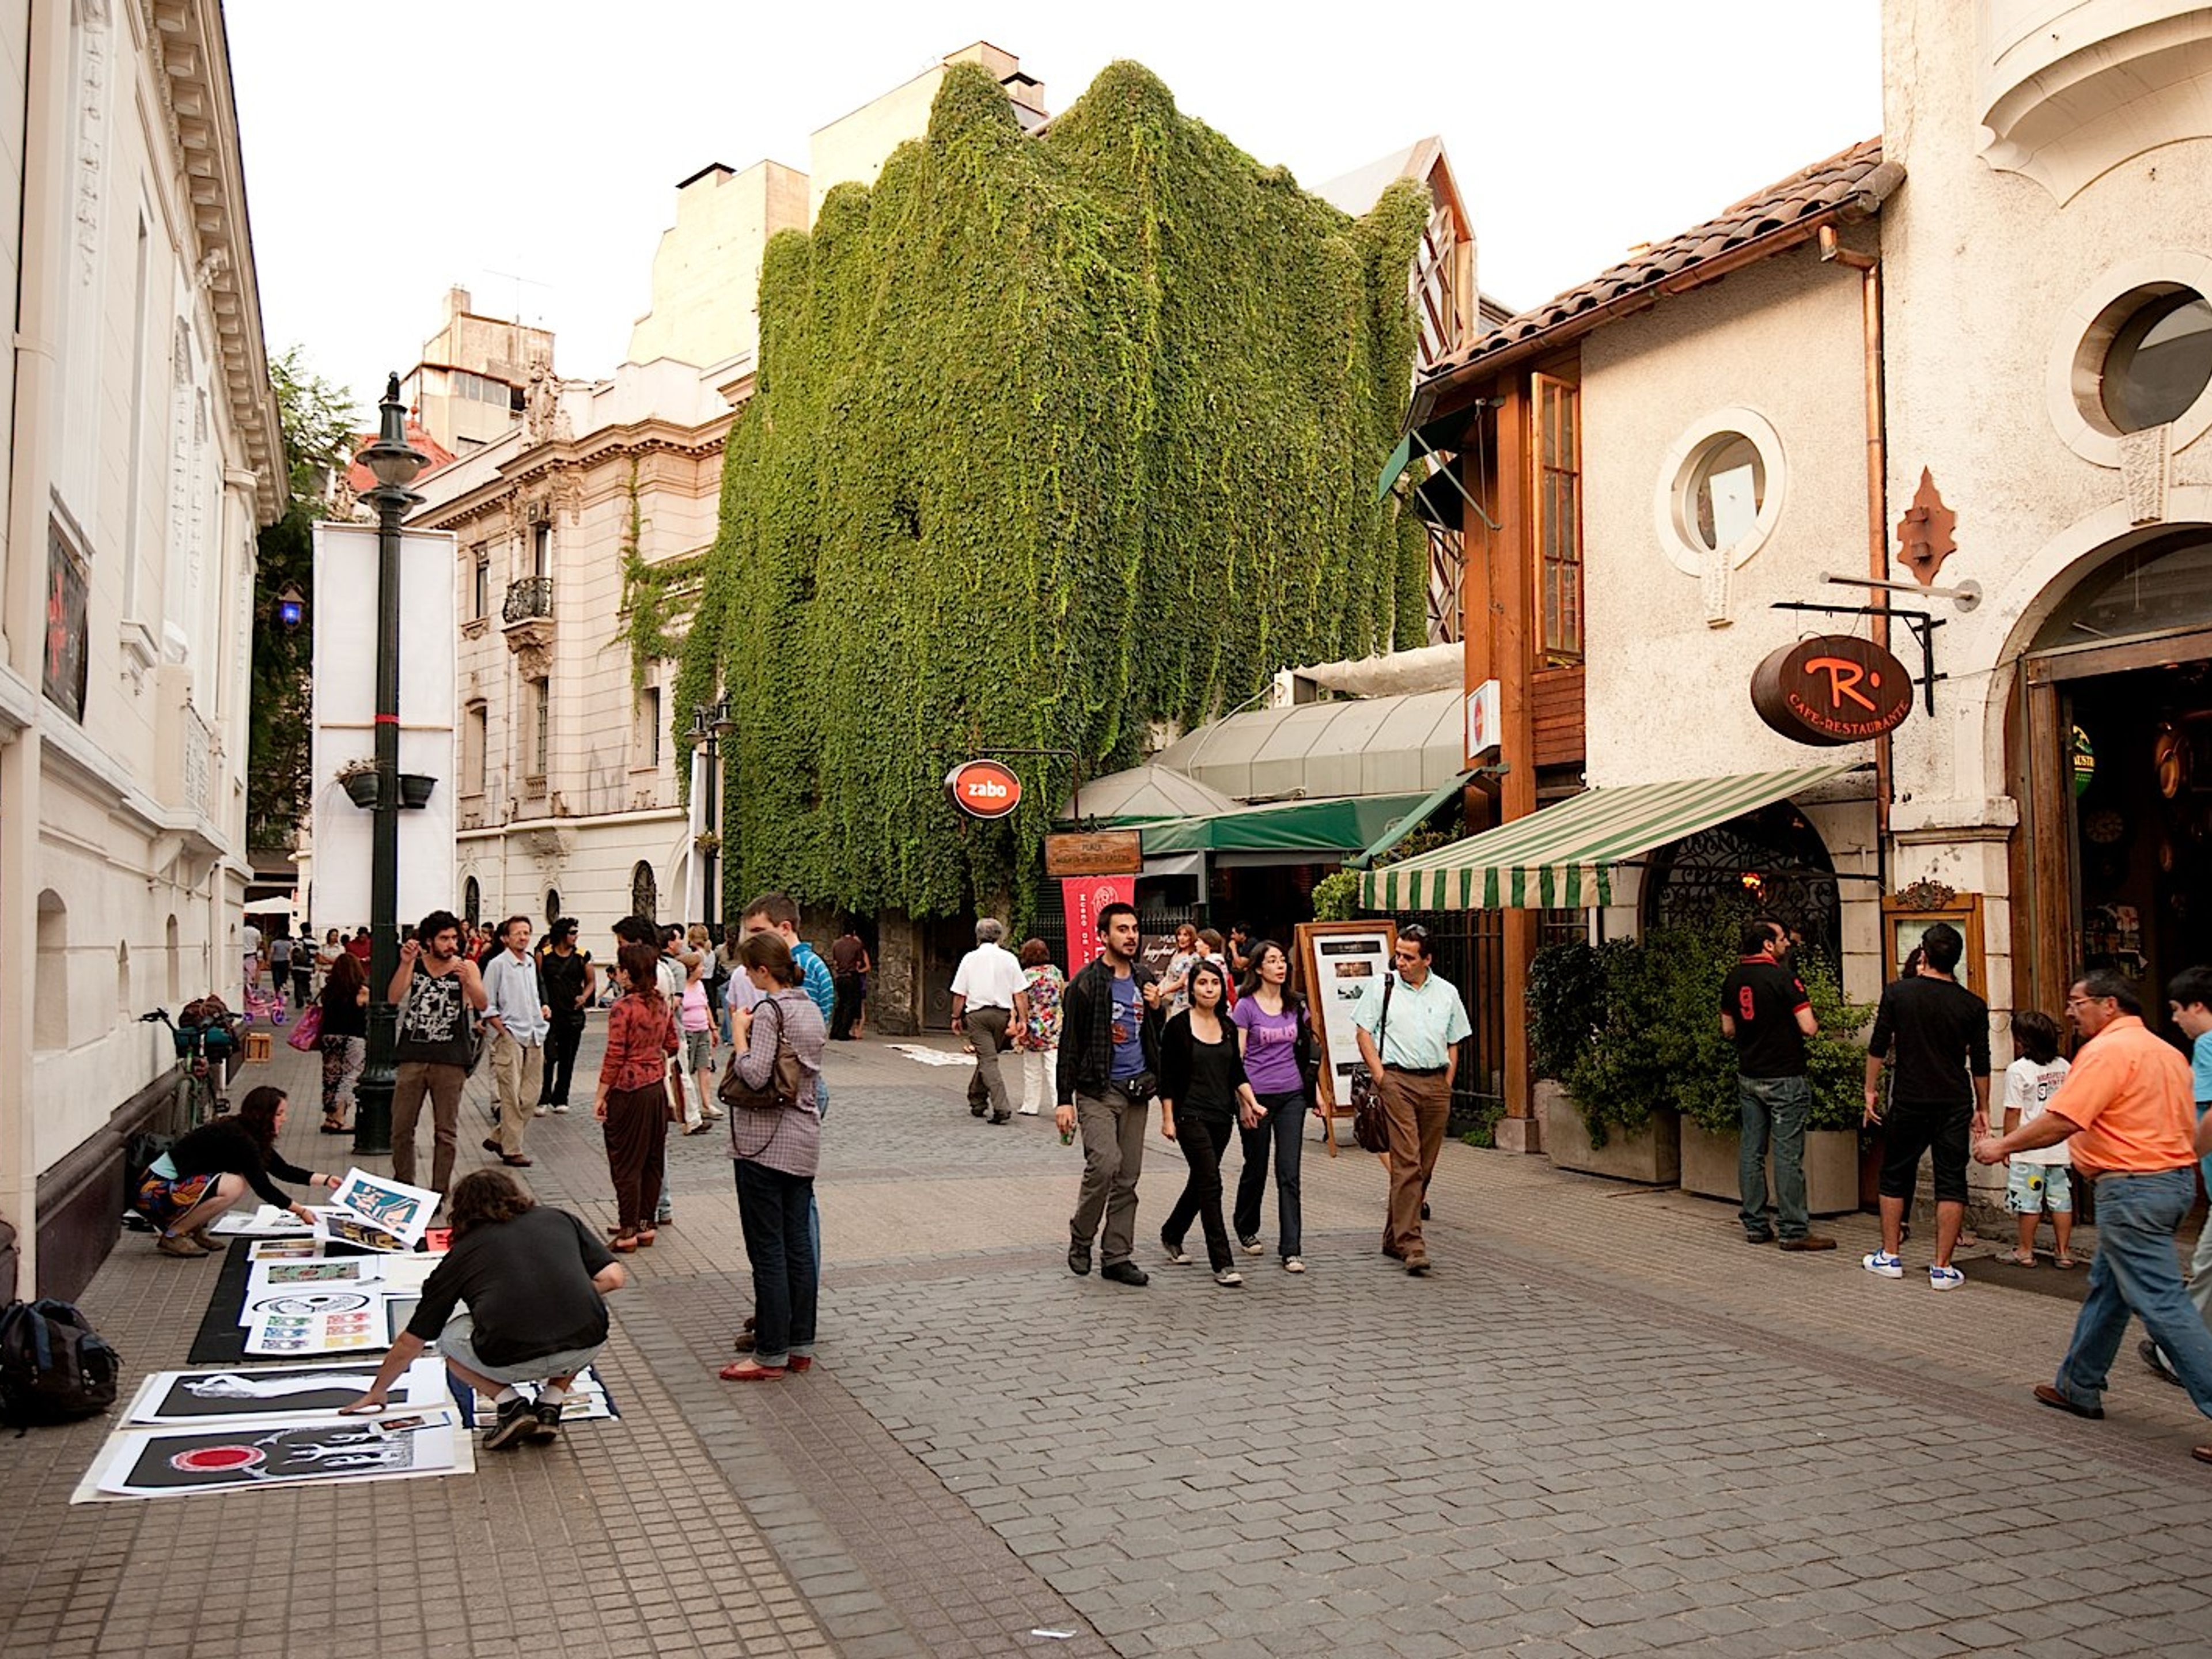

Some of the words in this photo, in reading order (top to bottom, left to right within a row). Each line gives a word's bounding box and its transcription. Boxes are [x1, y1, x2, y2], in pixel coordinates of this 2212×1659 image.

[968, 780, 1007, 797] zabo
[1740, 986, 1755, 1020] 9
[2037, 1083, 2048, 1101] 9
